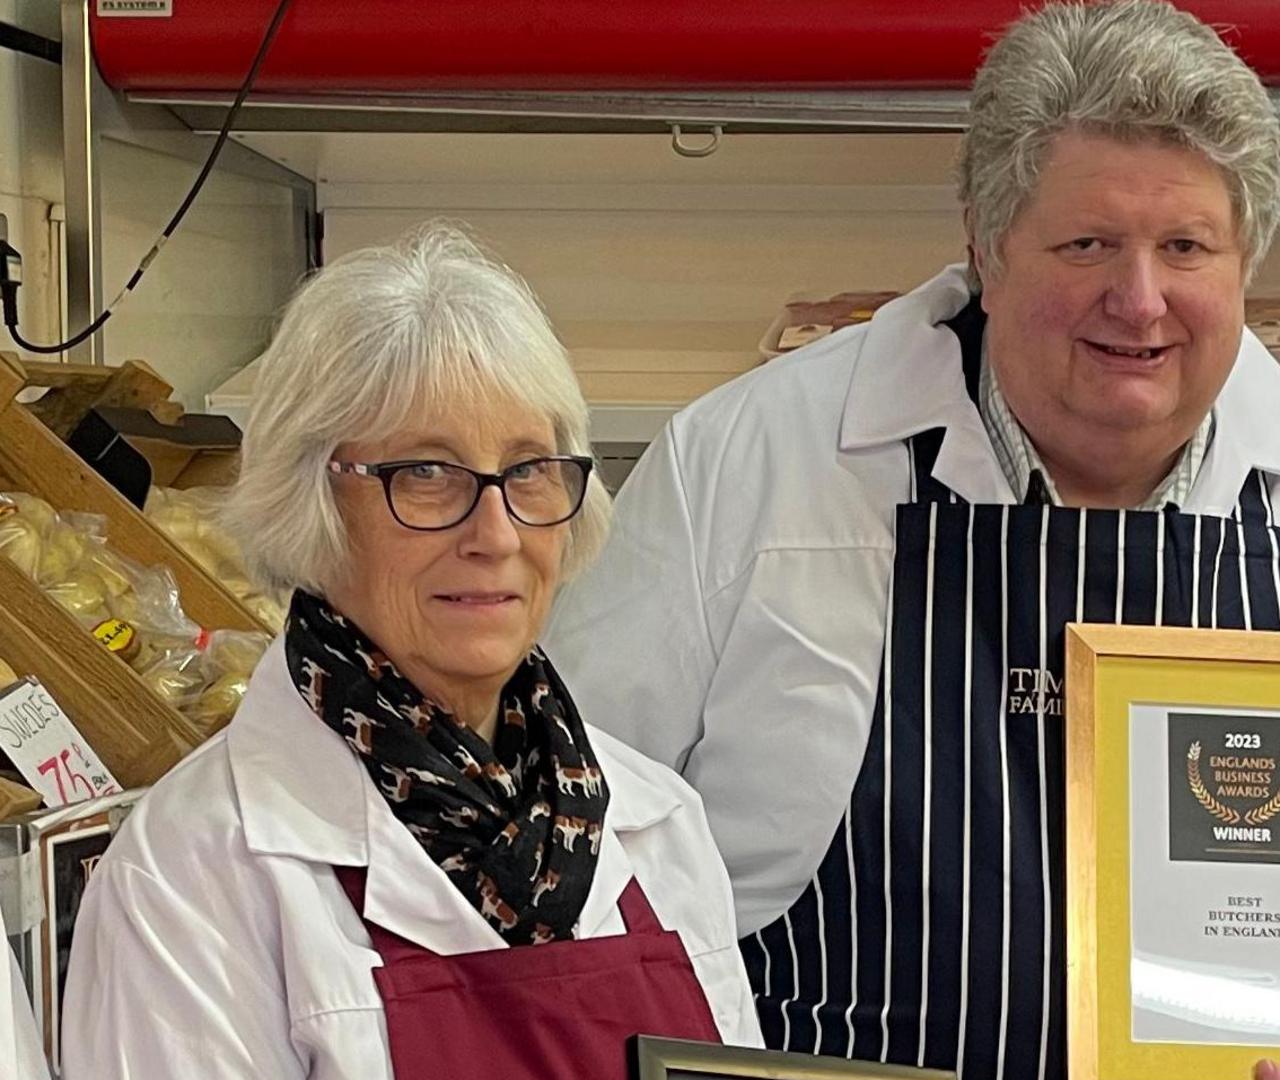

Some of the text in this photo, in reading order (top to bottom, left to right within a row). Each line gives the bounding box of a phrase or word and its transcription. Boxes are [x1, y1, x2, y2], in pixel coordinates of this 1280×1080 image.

[1009, 667, 1064, 694] TIM
[1008, 696, 1064, 716] FAMI
[1225, 733, 1261, 749] 2023
[1210, 756, 1276, 770] ENGLANDS
[1215, 771, 1271, 784] BUSINESS
[1216, 785, 1270, 798] AWARDS
[1213, 826, 1271, 842] WINNER
[1227, 896, 1263, 907] BEST
[1204, 926, 1218, 936] IN
